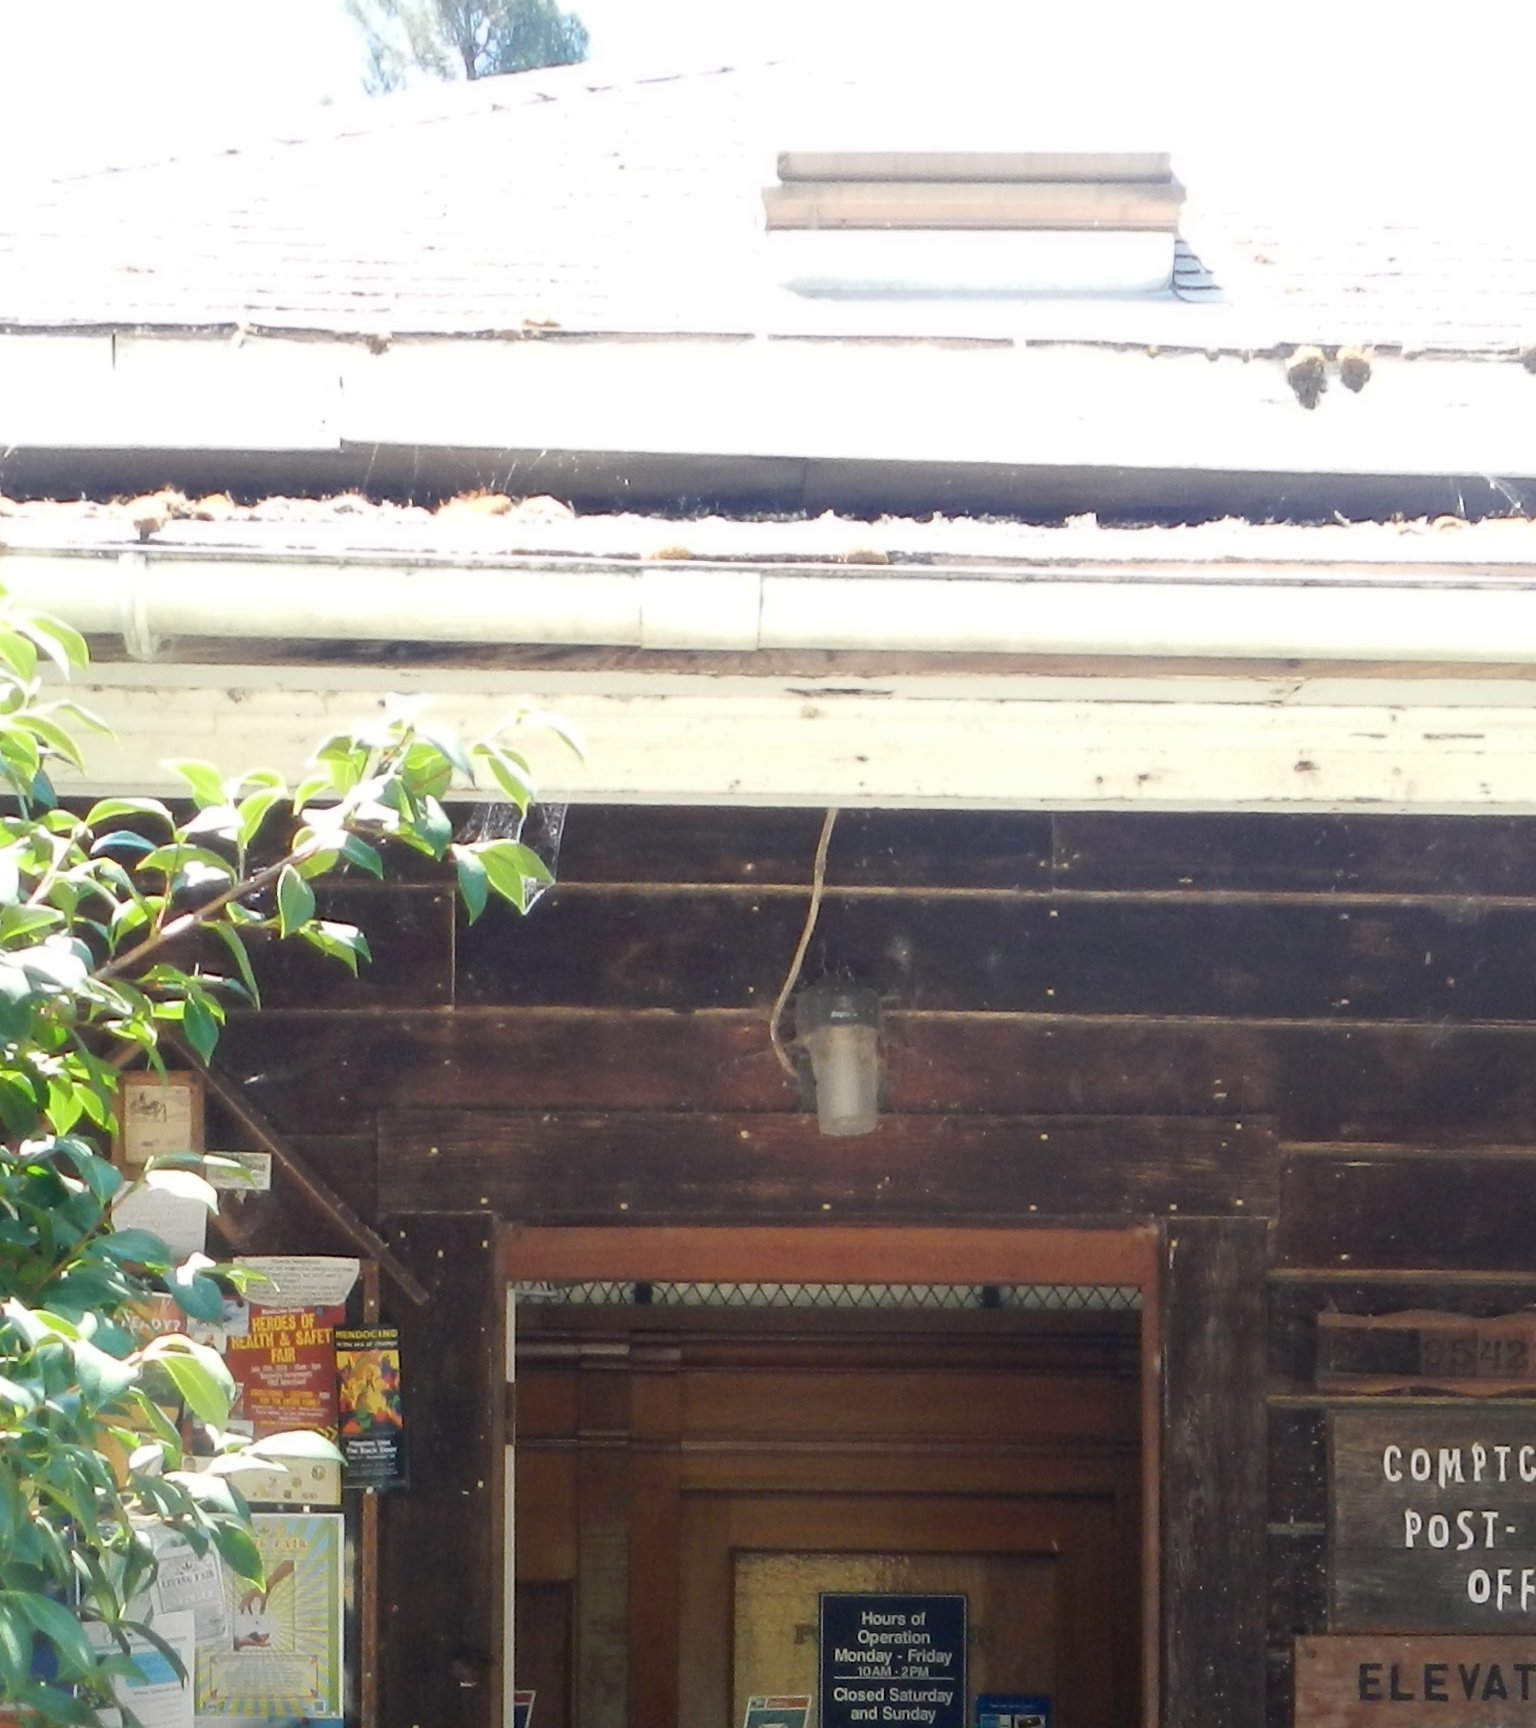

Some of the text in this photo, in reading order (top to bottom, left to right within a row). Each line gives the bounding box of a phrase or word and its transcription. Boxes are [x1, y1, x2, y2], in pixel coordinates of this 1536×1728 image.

[252, 1313, 316, 1333] HEROES OF
[231, 1328, 332, 1349] HEALTH & SAFET
[335, 1328, 399, 1341] MENDOCINO
[270, 1346, 297, 1363] FAIR
[1405, 1508, 1516, 1551] POST-
[861, 1611, 926, 1626] Hours of
[857, 1629, 931, 1647] Operation
[834, 1648, 893, 1666] Monday
[908, 1649, 953, 1667] Friday
[857, 1665, 892, 1677] 10AM
[901, 1665, 930, 1677] 2PM
[833, 1687, 953, 1706] Closed Saturday
[850, 1705, 936, 1724] and Sunday
